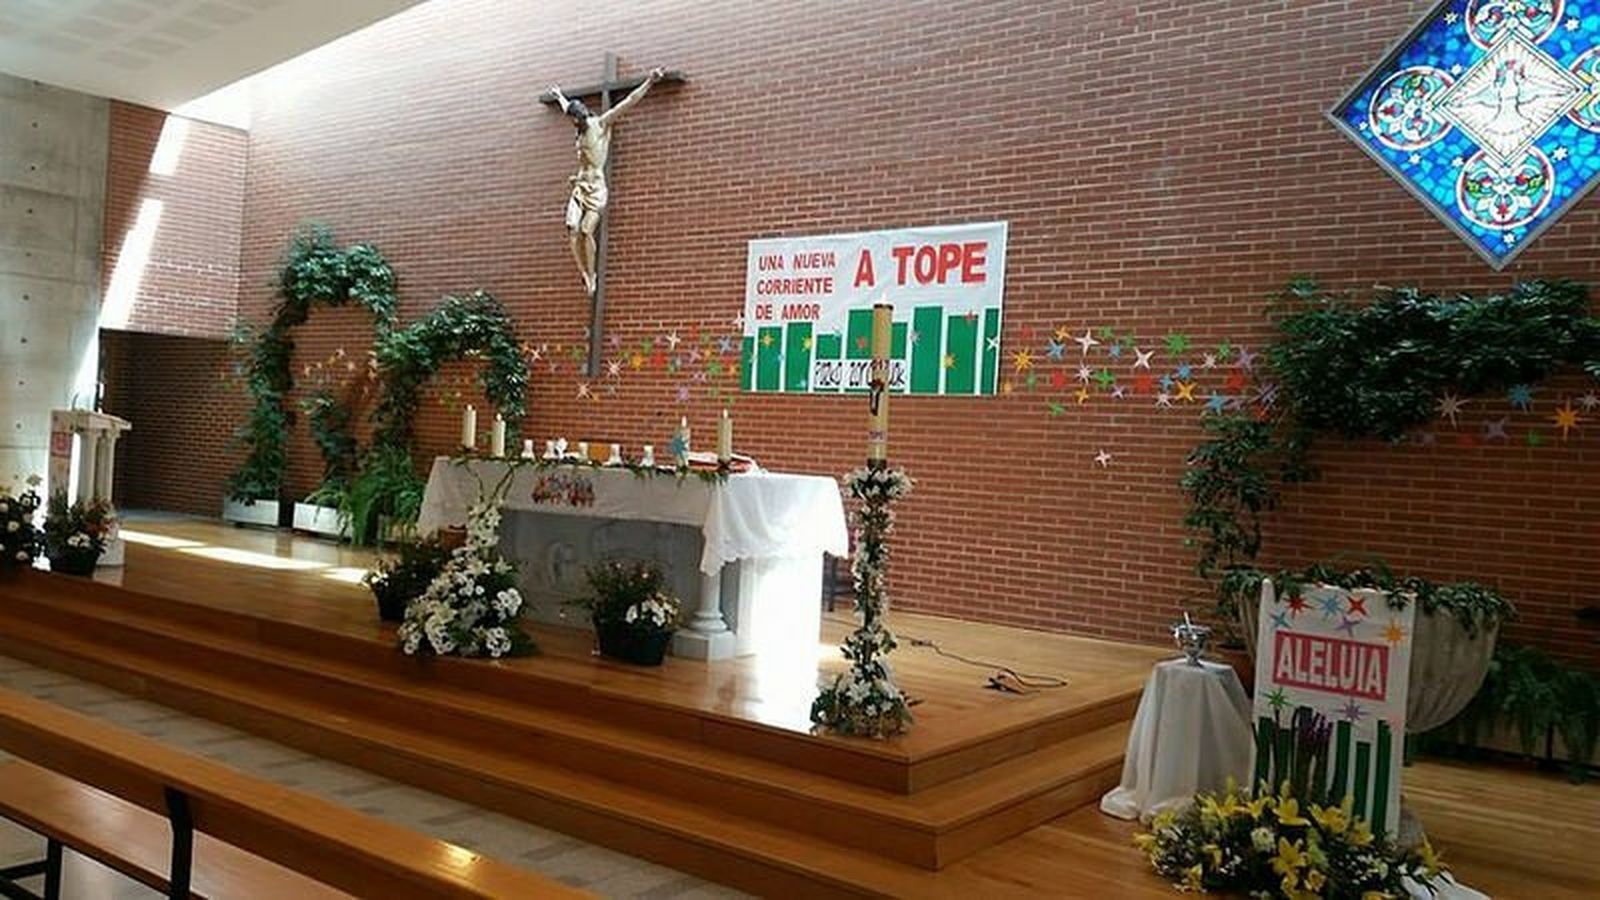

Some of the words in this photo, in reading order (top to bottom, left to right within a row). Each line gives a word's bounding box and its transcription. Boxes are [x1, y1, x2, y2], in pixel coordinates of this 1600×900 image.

[758, 255, 784, 271] UNA
[793, 252, 836, 269] NUEVA
[854, 249, 875, 287] A
[892, 243, 988, 285] TOPE
[757, 277, 833, 295] CORRIENTE
[755, 304, 773, 320] DE
[781, 303, 821, 320] AMOR
[1276, 637, 1383, 695] ALELUIA
